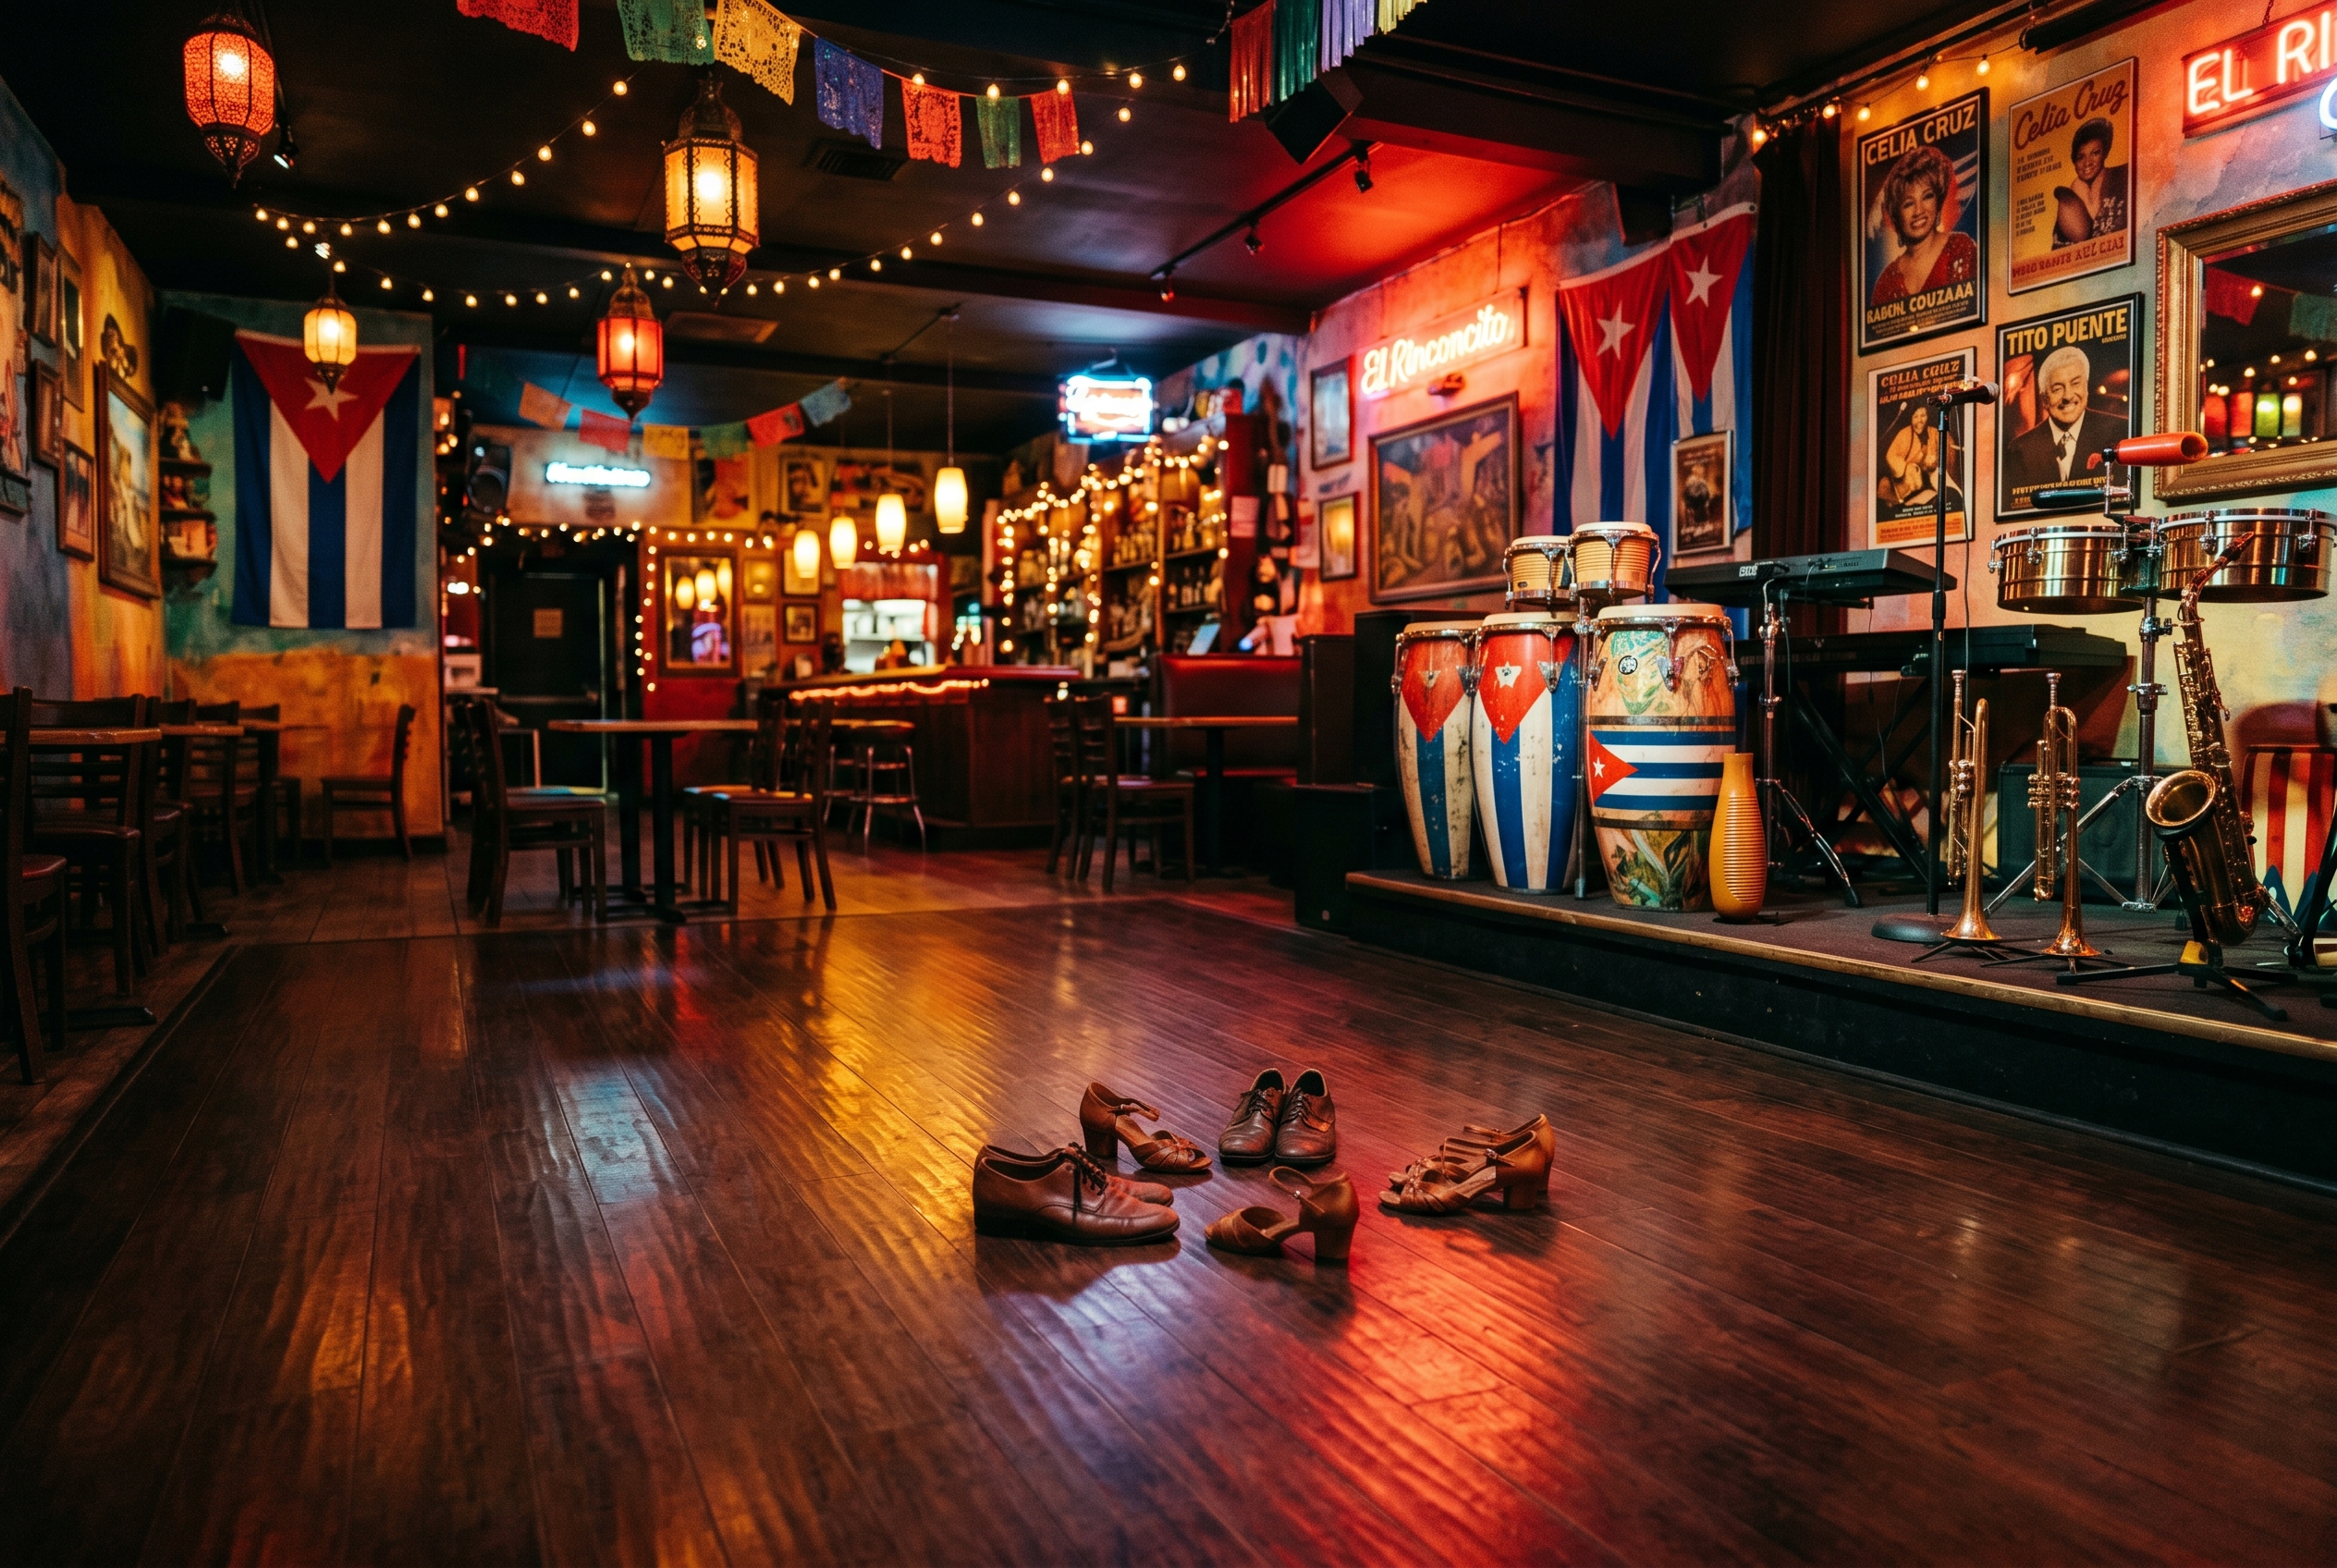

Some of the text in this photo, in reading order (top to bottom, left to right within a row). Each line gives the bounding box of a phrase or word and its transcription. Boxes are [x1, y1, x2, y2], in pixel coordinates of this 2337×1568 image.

[2014, 80, 2129, 150] Celia Cruz
[2187, 49, 2254, 115] EL
[1866, 104, 1976, 165] CELIA CRUZ
[1361, 303, 1510, 396] El Rinconcito
[2006, 307, 2128, 356] TITO PUENTE
